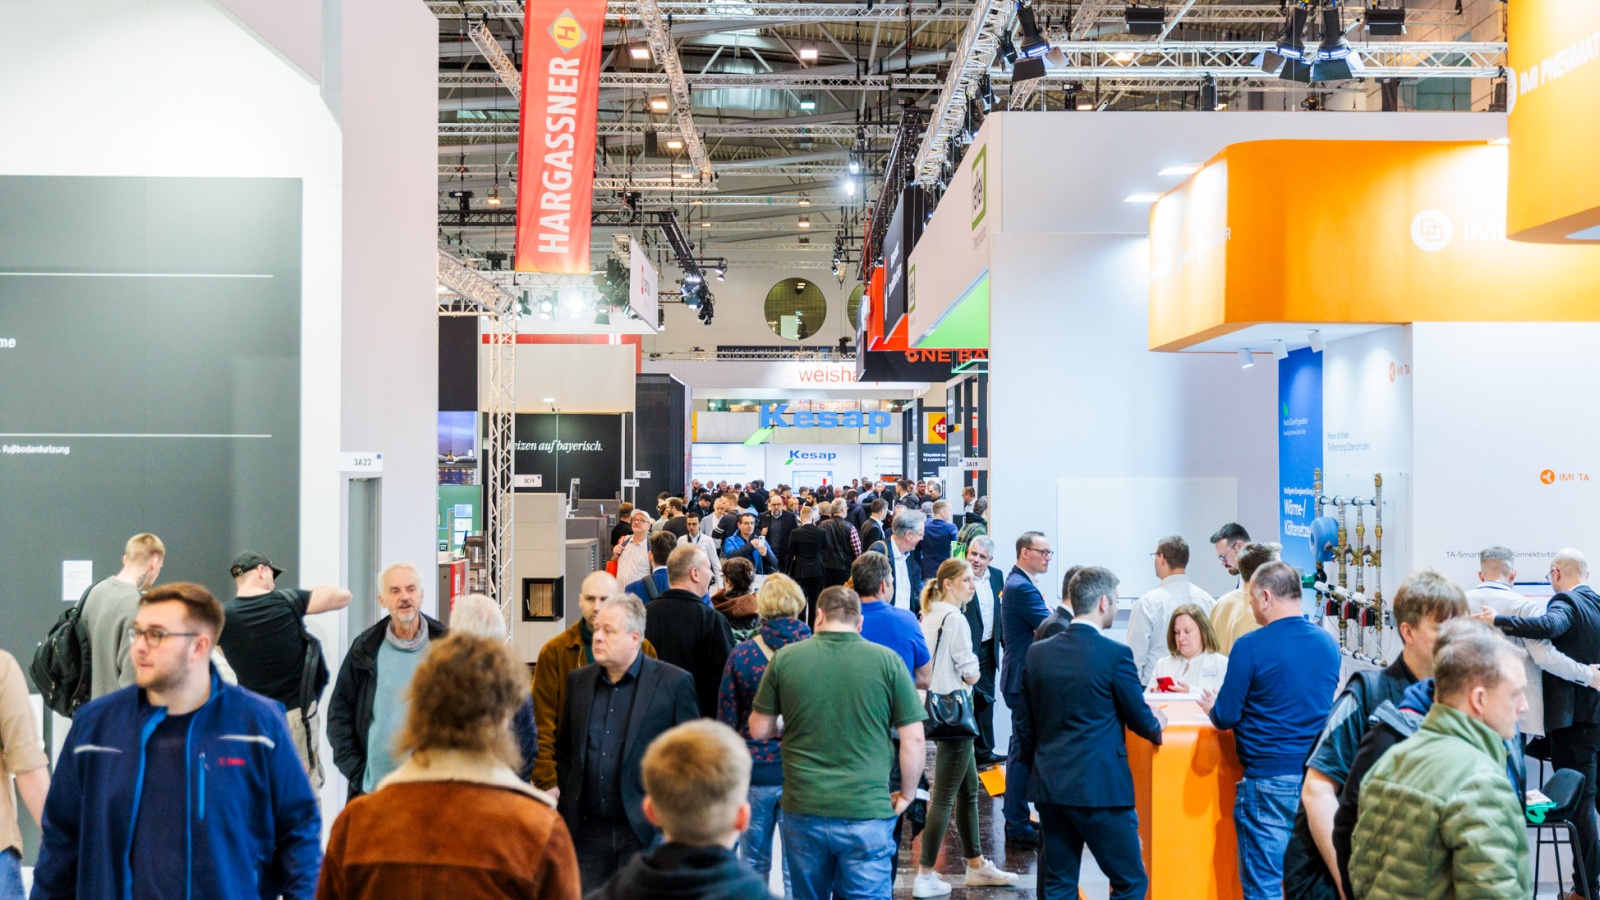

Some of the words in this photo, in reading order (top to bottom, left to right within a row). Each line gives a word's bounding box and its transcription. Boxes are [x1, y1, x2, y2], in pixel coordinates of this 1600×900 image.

[1520, 65, 1538, 96] IMI
[538, 57, 580, 254] HARGASSNER
[761, 404, 891, 434] Kesap
[2, 444, 71, 455] Fußbodenheizung
[538, 439, 557, 453] auf
[556, 439, 603, 453] bayerisch.
[789, 450, 837, 461] Kesap
[353, 457, 372, 467] 3A22
[1559, 473, 1575, 481] IMI
[1578, 473, 1590, 481] TA
